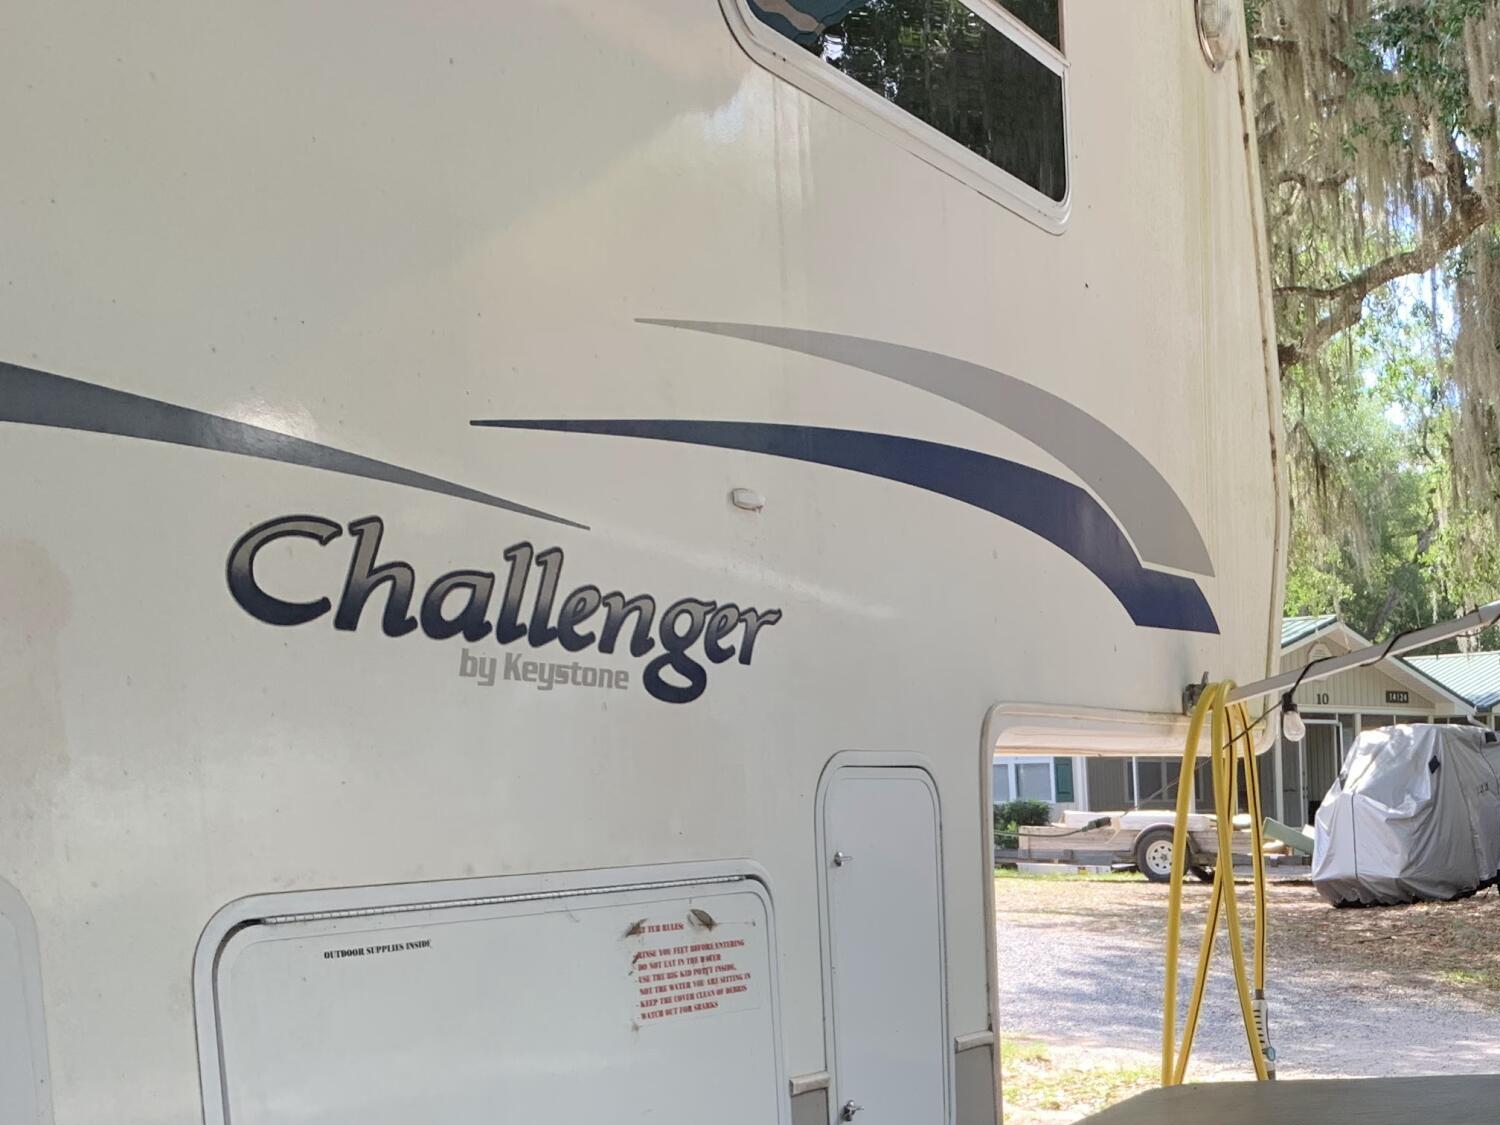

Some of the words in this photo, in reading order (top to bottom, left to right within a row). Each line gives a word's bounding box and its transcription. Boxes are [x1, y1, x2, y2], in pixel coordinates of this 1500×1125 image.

[226, 514, 782, 704] Challenger
[459, 648, 496, 687] by
[503, 651, 630, 691] Keystone
[1317, 693, 1329, 705] 10
[324, 947, 365, 959] OUTDOOR
[366, 943, 404, 955] SUPPLIES
[405, 939, 431, 950] INSIDE
[690, 943, 713, 952] BEFORE
[715, 939, 745, 949] ENTERING
[650, 961, 662, 969] NOT
[686, 956, 698, 965] THE
[639, 975, 650, 983] USE
[652, 973, 665, 982] THE
[680, 969, 692, 978] KID
[640, 987, 652, 995] NOT
[655, 984, 667, 993] THE
[669, 981, 691, 991] WATER
[720, 973, 743, 984] SITTING
[744, 972, 751, 980] IN
[640, 998, 657, 1008] KEEP
[660, 996, 672, 1005] THE
[674, 992, 695, 1003] COVER
[696, 990, 715, 1000] CLEAN
[716, 988, 724, 996] OF
[725, 985, 747, 995] DEBRIS
[641, 1009, 664, 1020] WATCH
[665, 1007, 678, 1016] OUT
[679, 1005, 692, 1014] FOR
[694, 1001, 719, 1011] SHARKS
